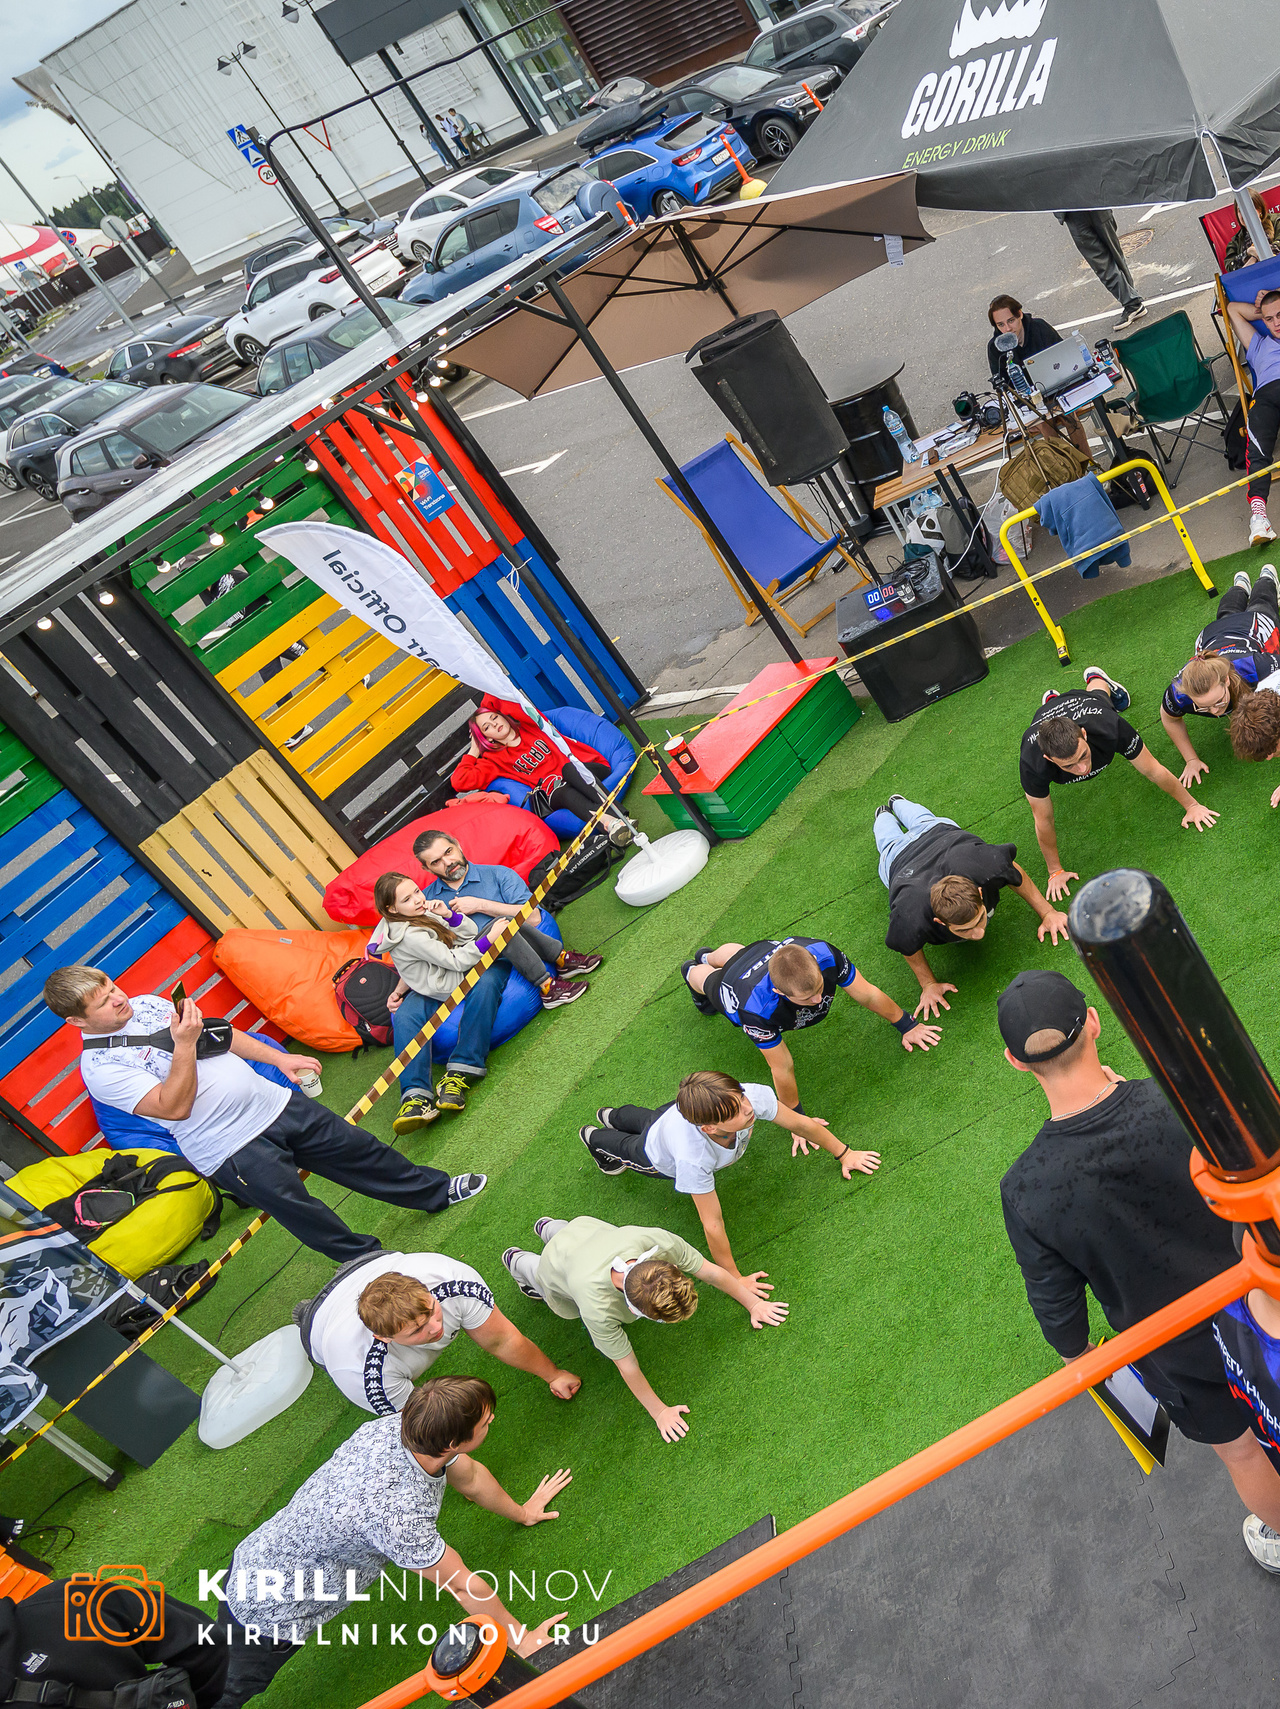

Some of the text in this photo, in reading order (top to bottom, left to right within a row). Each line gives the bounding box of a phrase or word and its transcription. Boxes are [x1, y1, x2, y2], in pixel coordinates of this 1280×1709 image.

[901, 37, 1058, 139] GORILLA
[902, 129, 1011, 169] ENERGY DRINK
[263, 170, 274, 180] 20
[868, 585, 895, 604] 00 00
